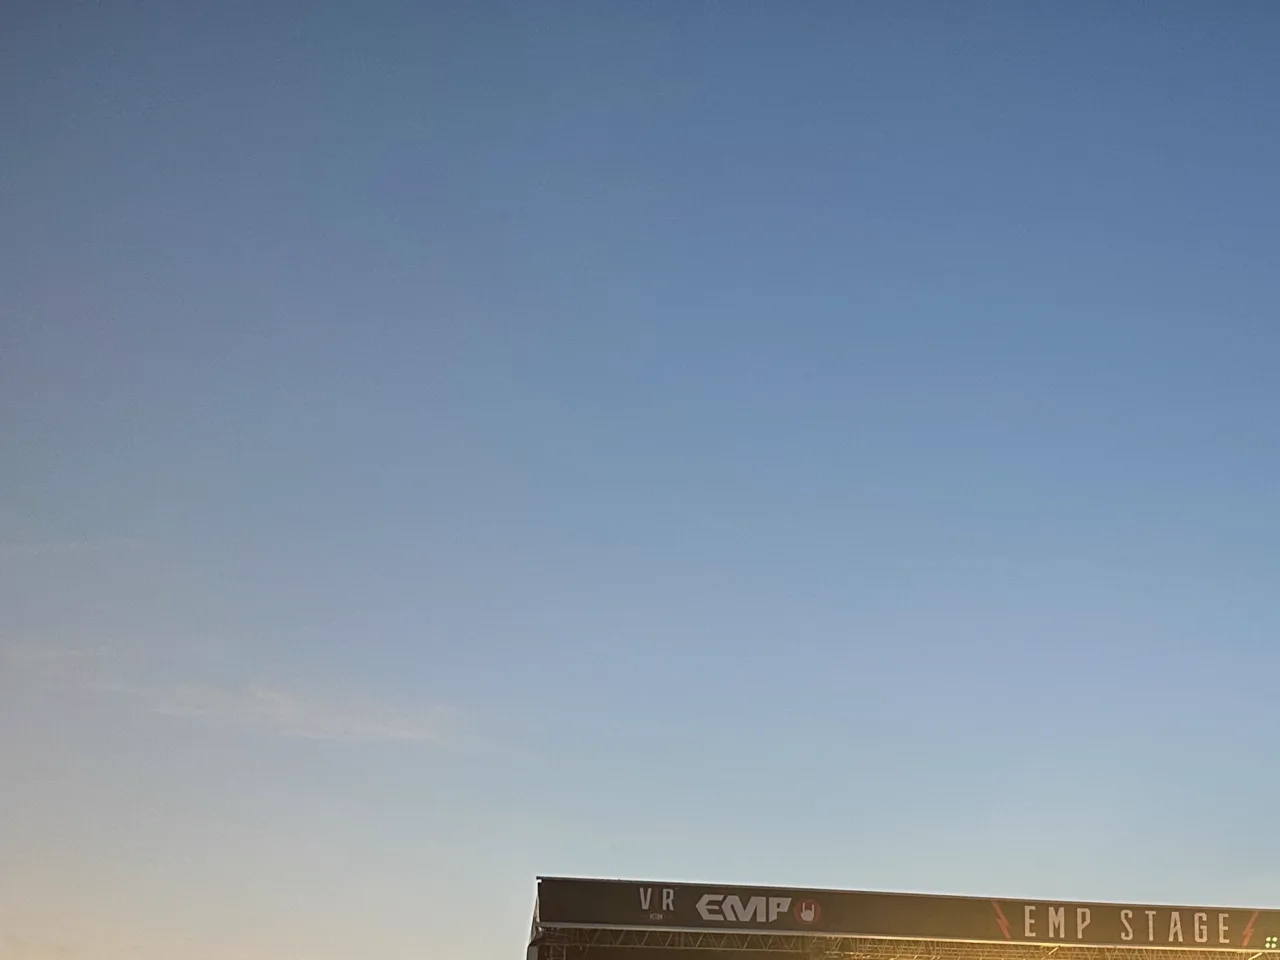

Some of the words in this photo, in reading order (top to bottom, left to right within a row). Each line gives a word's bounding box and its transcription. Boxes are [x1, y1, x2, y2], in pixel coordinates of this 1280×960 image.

[695, 893, 792, 923] EMP
[1024, 905, 1091, 939] EMP
[1120, 909, 1230, 944] STAGE
